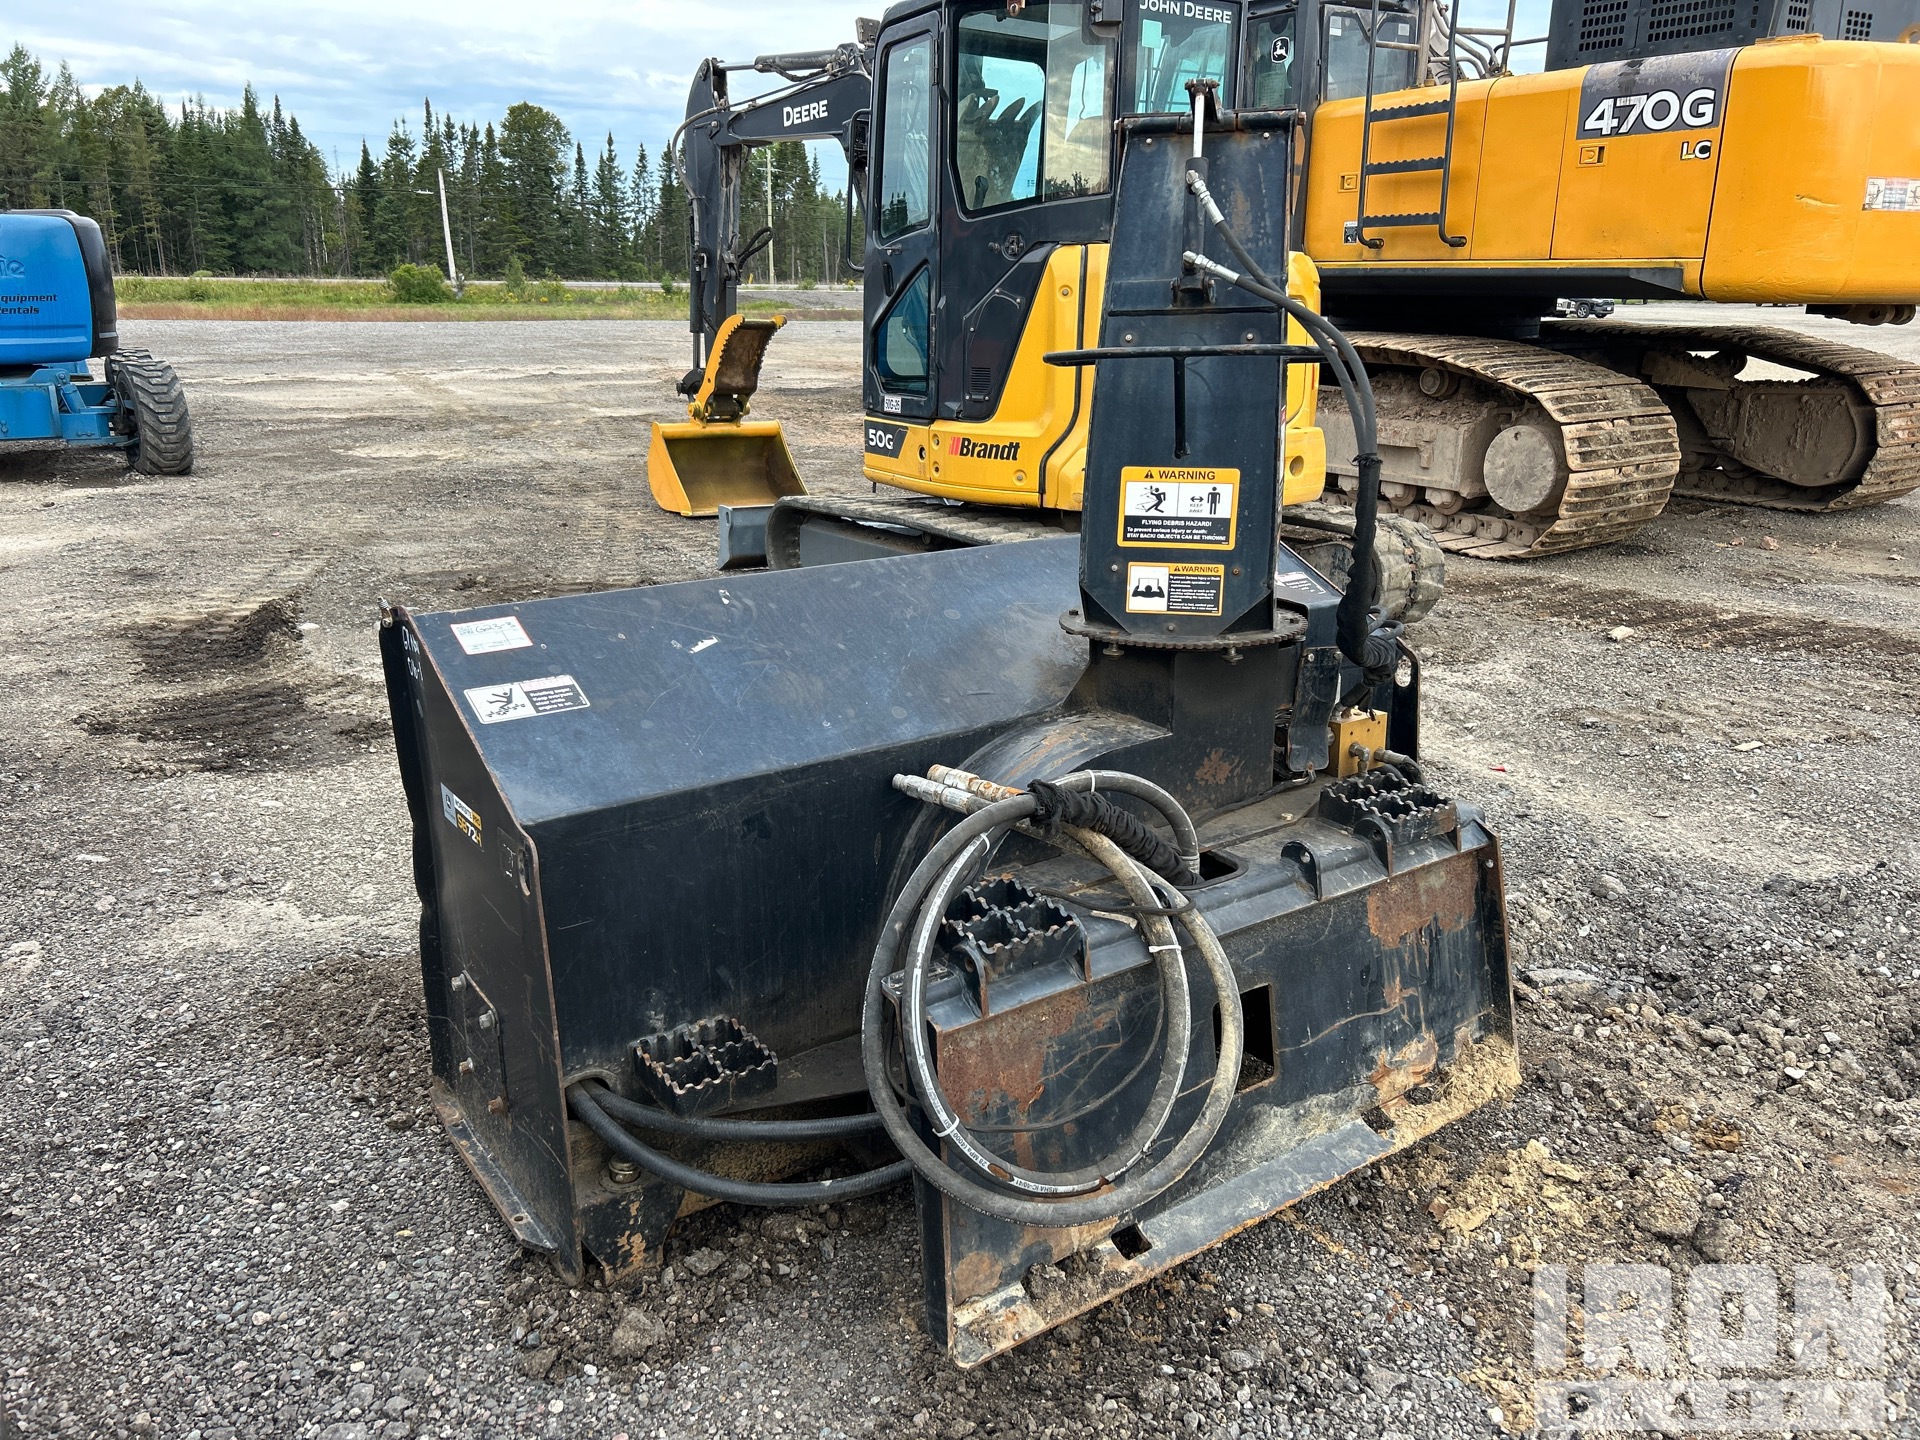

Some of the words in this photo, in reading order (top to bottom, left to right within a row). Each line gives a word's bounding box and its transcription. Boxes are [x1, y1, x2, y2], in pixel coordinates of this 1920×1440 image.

[1140, 0, 1180, 15] JOHN
[1184, 2, 1232, 24] DEERE
[783, 99, 828, 127] DEERE
[1583, 87, 1716, 136] 470G
[1680, 140, 1712, 160] LC
[0, 293, 58, 304] quipment
[0, 306, 40, 315] entals
[868, 429, 894, 450] 50G
[959, 437, 1020, 461] Brandt
[1158, 470, 1216, 480] WARNING
